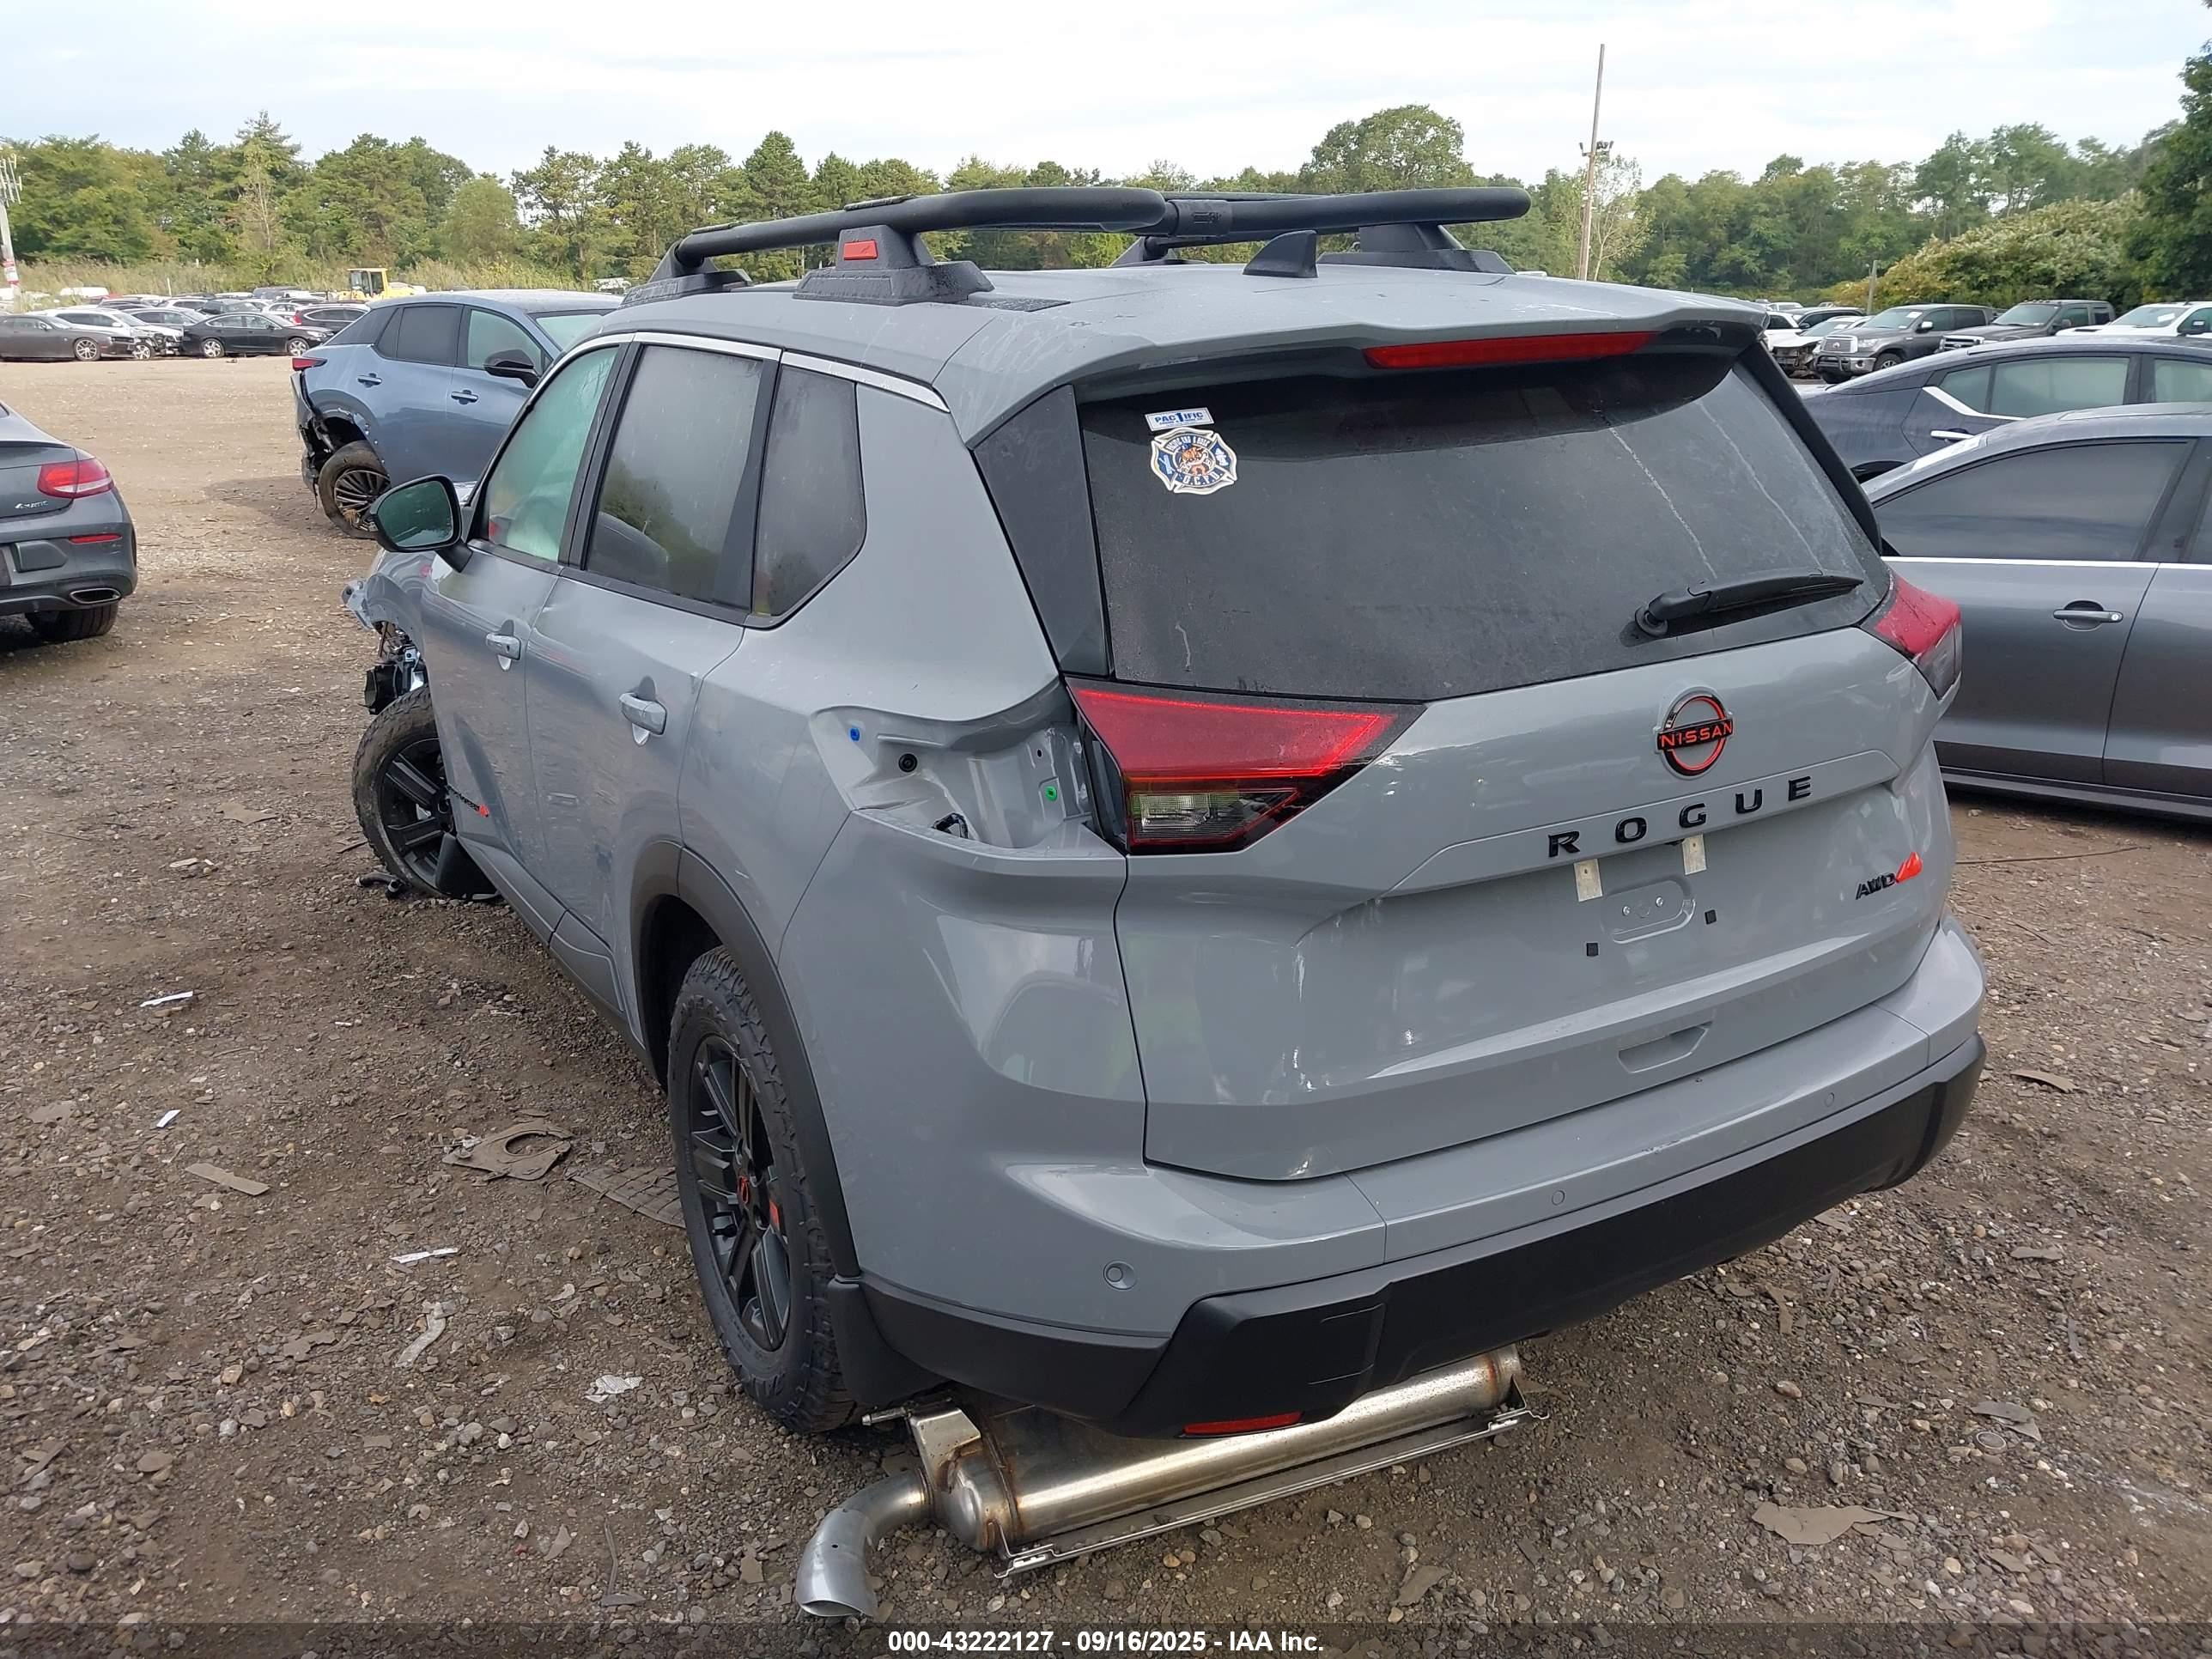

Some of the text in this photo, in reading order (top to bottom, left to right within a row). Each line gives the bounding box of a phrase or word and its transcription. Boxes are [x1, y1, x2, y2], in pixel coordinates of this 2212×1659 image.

[1660, 720, 1733, 748] NISSAN
[1548, 775, 1811, 858] ROGUE
[1855, 872, 1896, 900] AWD
